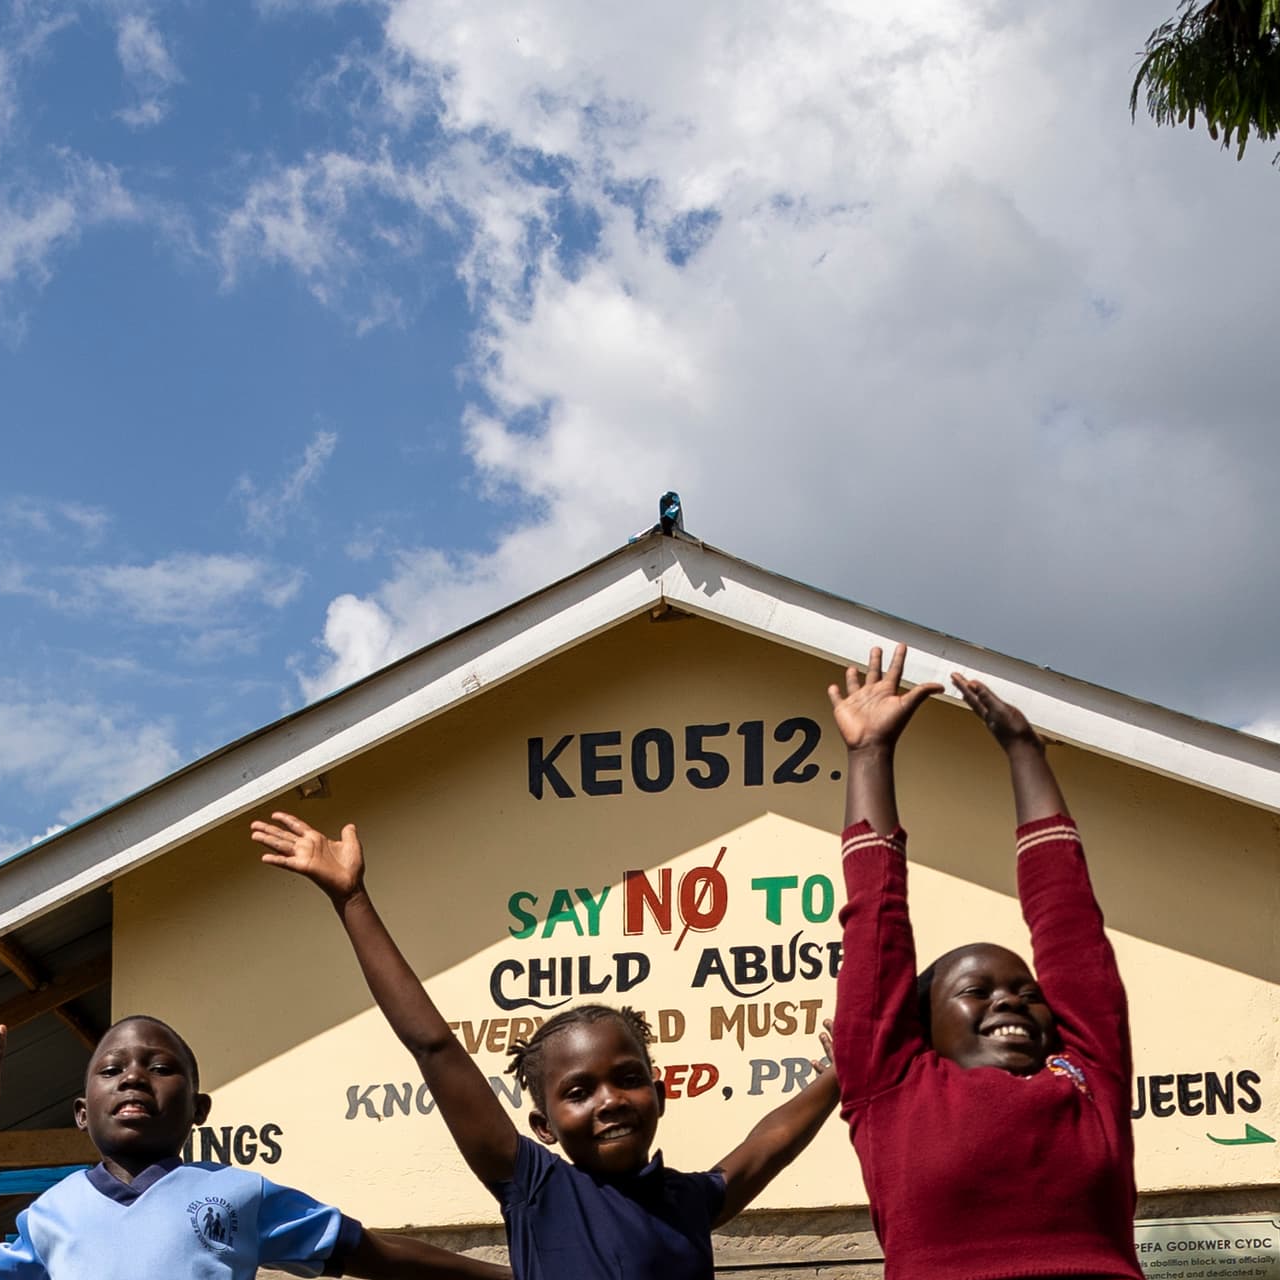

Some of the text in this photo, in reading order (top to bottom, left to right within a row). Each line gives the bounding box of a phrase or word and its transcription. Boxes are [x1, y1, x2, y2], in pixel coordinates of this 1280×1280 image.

[508, 886, 612, 939] SAY
[752, 874, 835, 926] TO
[490, 952, 651, 1010] CHILD
[710, 999, 823, 1051] MUST
[1130, 1070, 1262, 1119] UEENS
[183, 1123, 283, 1166] INGS
[1167, 1240, 1231, 1252] GODKWER
[1235, 1238, 1272, 1249] CYDC
[1191, 1256, 1217, 1266] block
[1219, 1257, 1237, 1265] was
[1145, 1268, 1267, 1280] aunched and dedicated by
